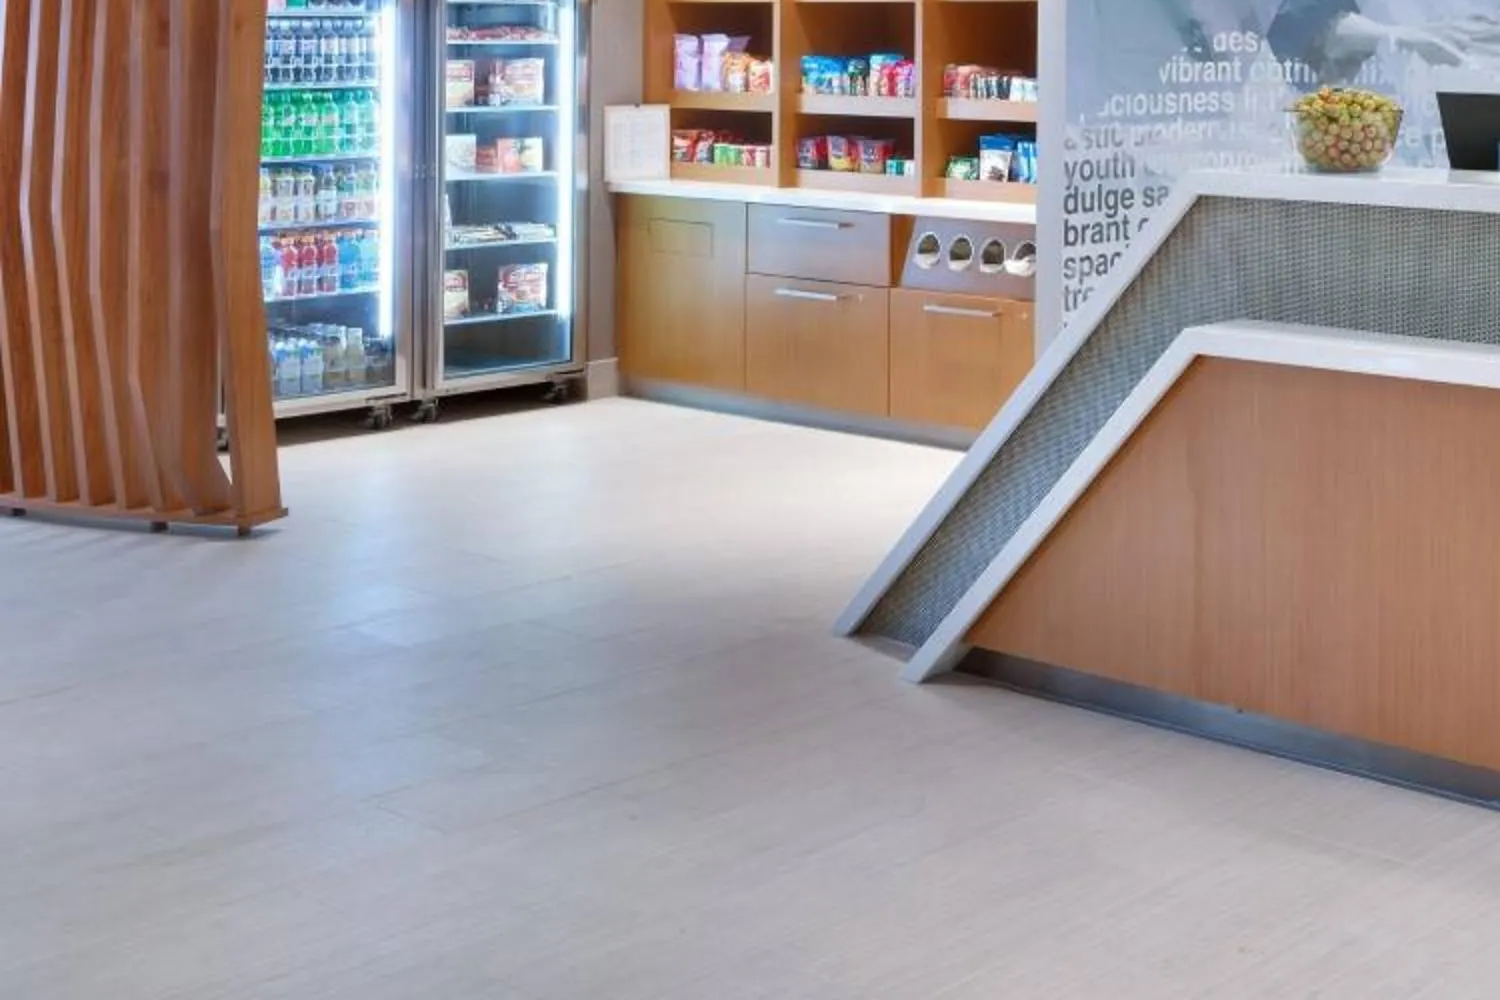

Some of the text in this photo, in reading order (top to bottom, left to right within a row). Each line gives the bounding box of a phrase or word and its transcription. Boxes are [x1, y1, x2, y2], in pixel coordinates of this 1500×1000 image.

[1158, 55, 1242, 85] vibrant
[1063, 151, 1135, 191] youth
[1063, 184, 1135, 218] dulge
[1063, 214, 1131, 246] brant
